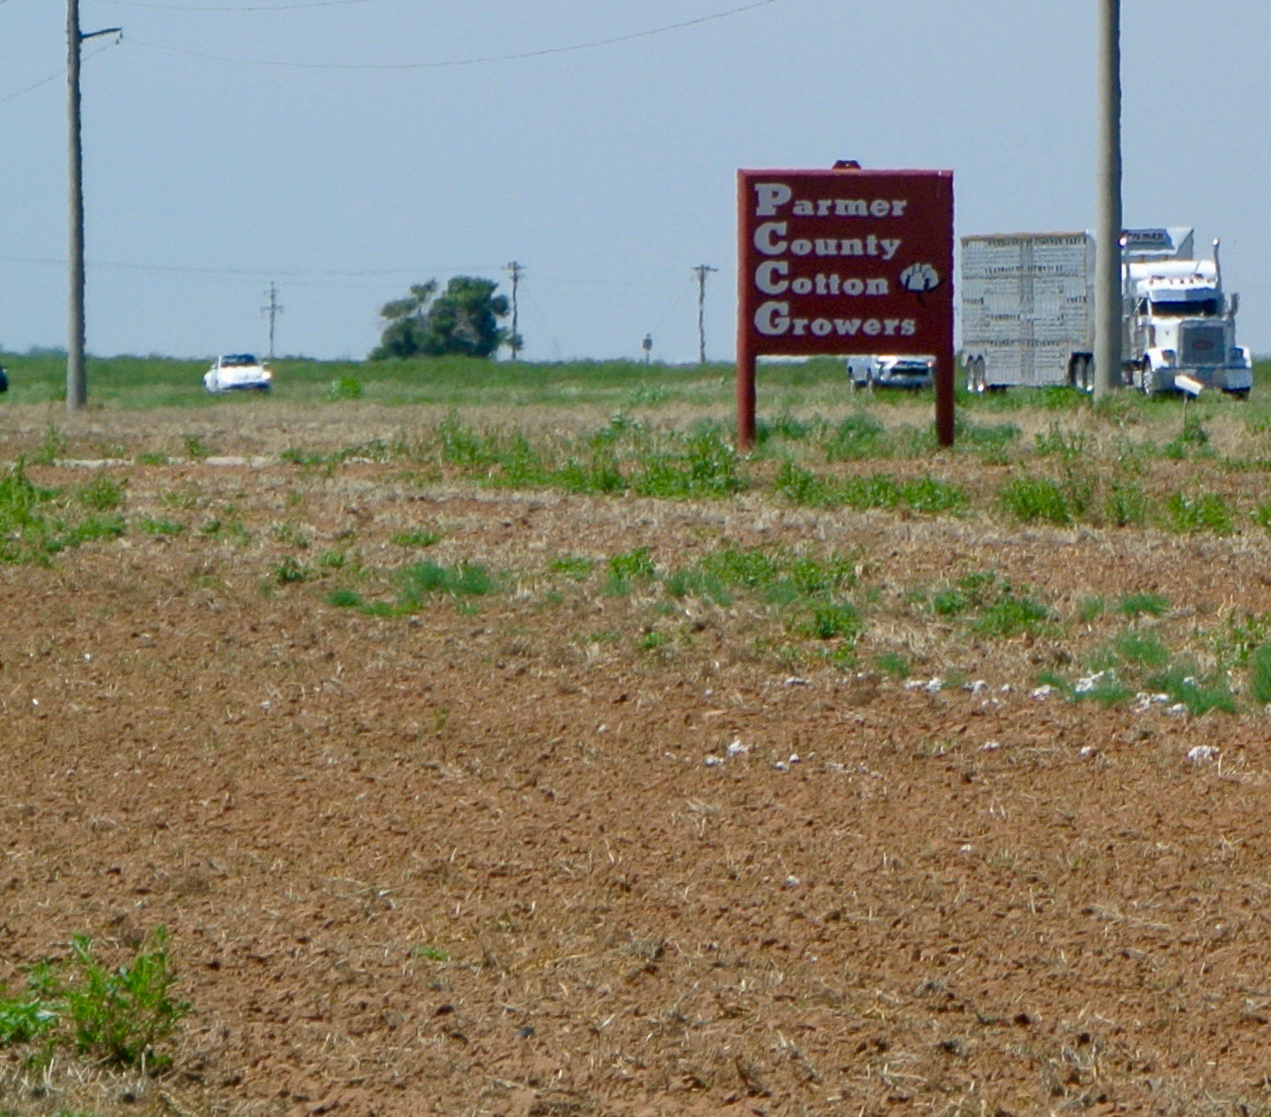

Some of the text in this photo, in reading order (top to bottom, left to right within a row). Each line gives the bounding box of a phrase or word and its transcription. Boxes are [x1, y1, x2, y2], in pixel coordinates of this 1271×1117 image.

[754, 182, 907, 217] Parmer
[754, 221, 901, 260] County
[755, 260, 889, 296] Cotton
[754, 300, 916, 336] Growers
